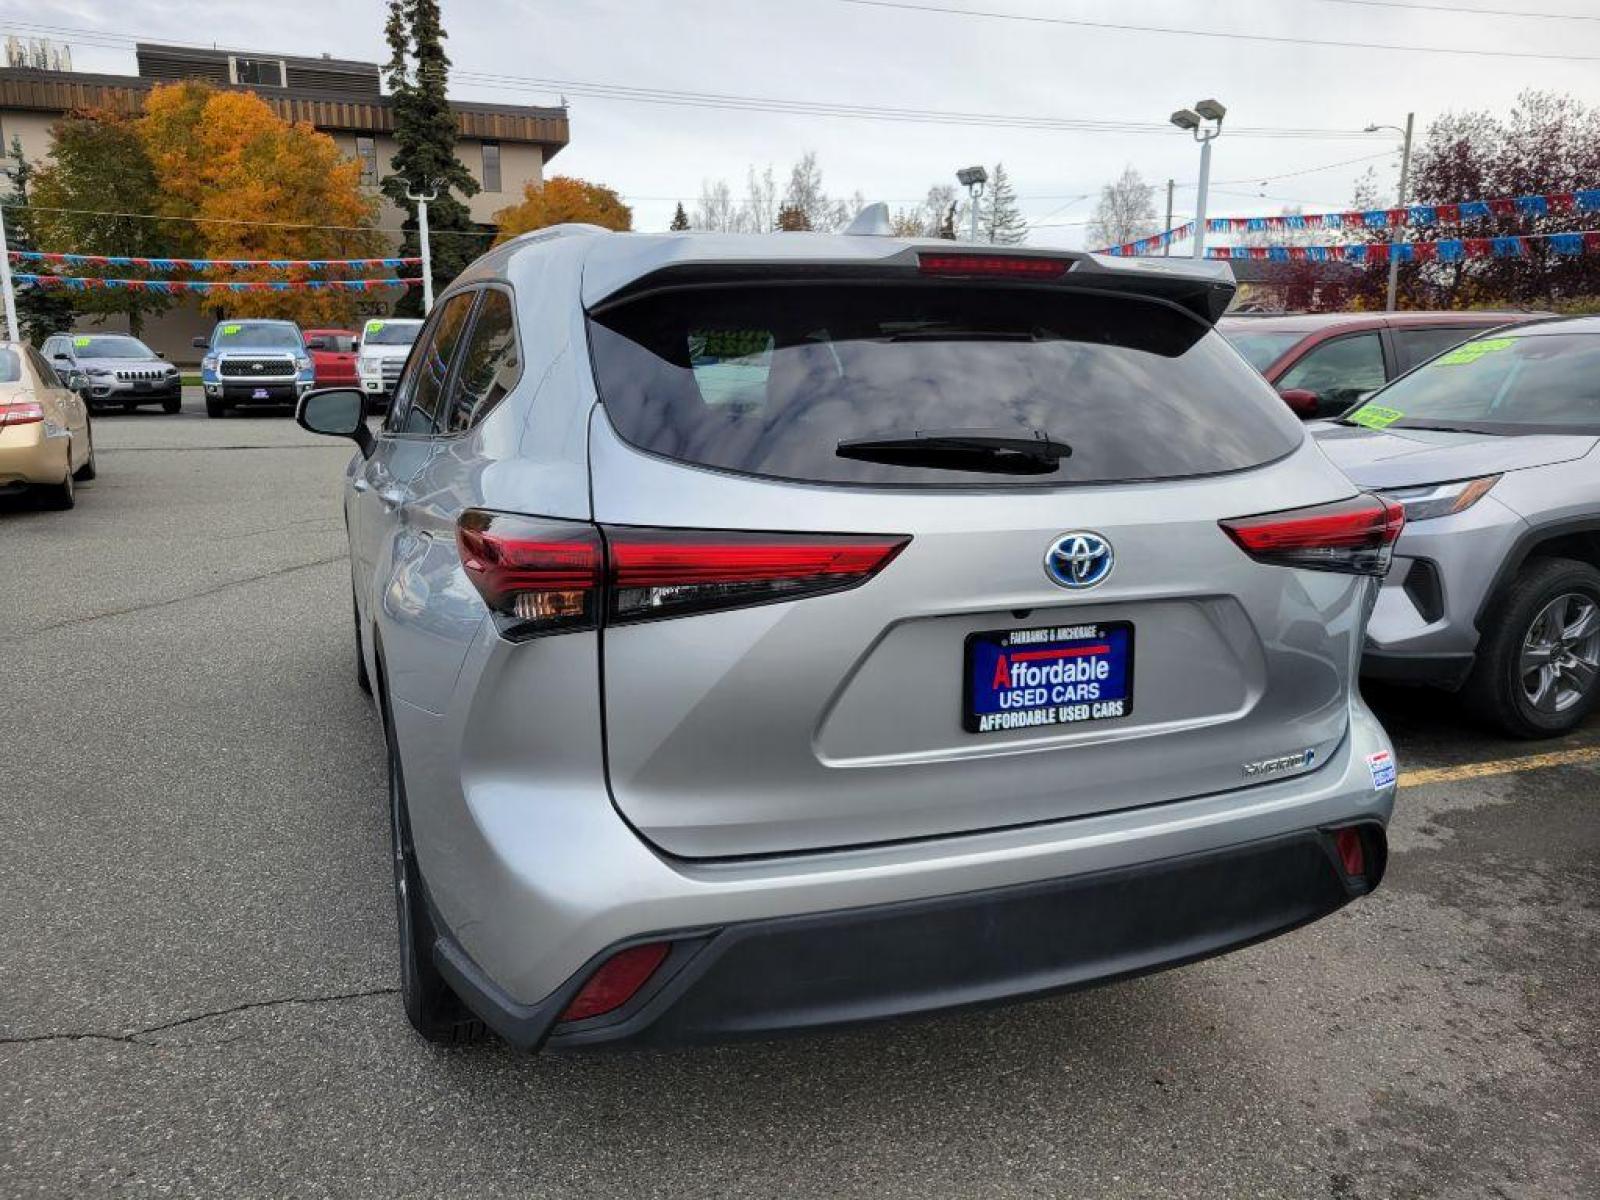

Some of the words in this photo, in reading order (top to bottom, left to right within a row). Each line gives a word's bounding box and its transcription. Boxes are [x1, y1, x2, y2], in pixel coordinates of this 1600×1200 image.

[993, 655, 1109, 689] Affordable
[1000, 689, 1048, 708] USED
[1052, 683, 1099, 702] CARS
[980, 709, 1056, 731] AFFORDABLE
[1060, 704, 1089, 721] USED
[1092, 701, 1123, 716] CARS
